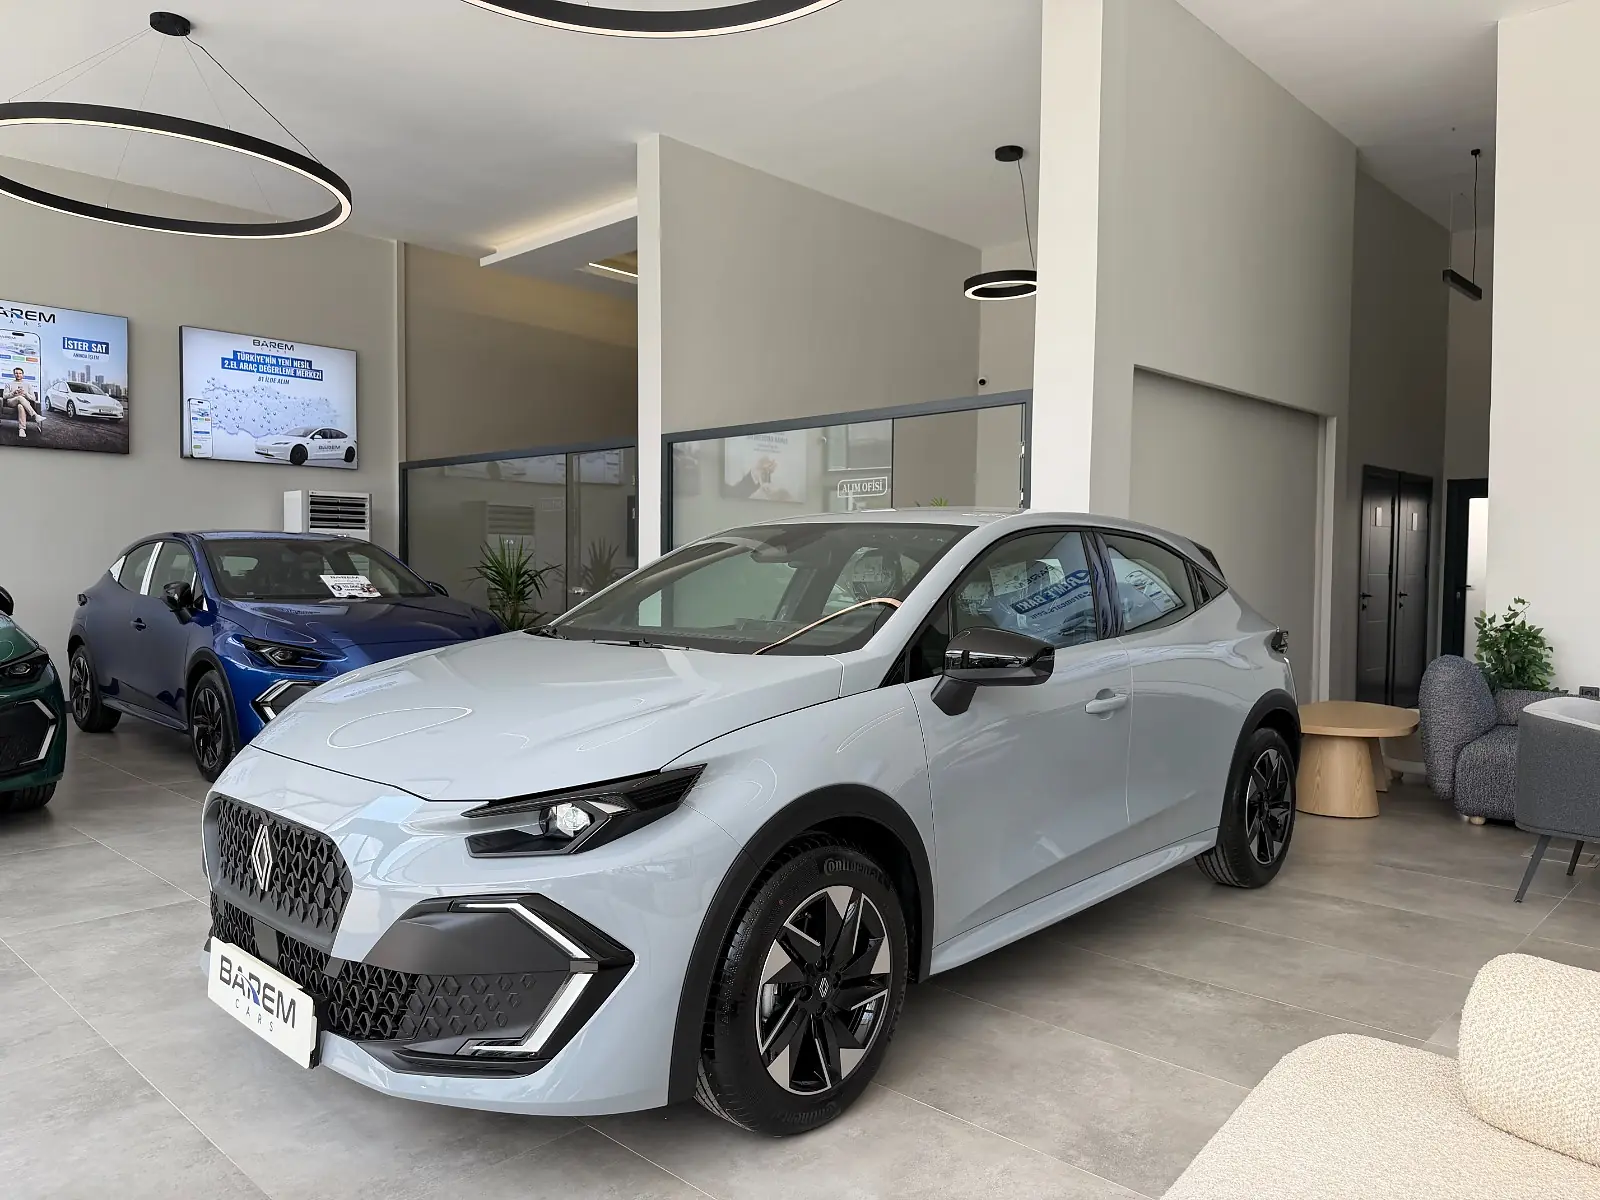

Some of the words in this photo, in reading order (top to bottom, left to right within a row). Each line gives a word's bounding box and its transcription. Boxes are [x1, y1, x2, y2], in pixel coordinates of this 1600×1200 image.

[0, 306, 56, 324] AREM
[9, 319, 42, 328] ARS
[64, 337, 89, 351] İSTER
[91, 342, 107, 353] SAT
[252, 339, 295, 352] BAREM
[236, 351, 277, 365] TÜRKİYE'NİN
[277, 356, 292, 367] YENİ
[224, 360, 238, 369] 2.EL
[239, 362, 257, 372] ARAÇ
[258, 362, 295, 376] DEĞERLEME
[842, 483, 861, 493] ALIM
[862, 479, 883, 492] OFİSİ
[220, 954, 296, 1029] BAREM
[235, 998, 274, 1032] CARS
